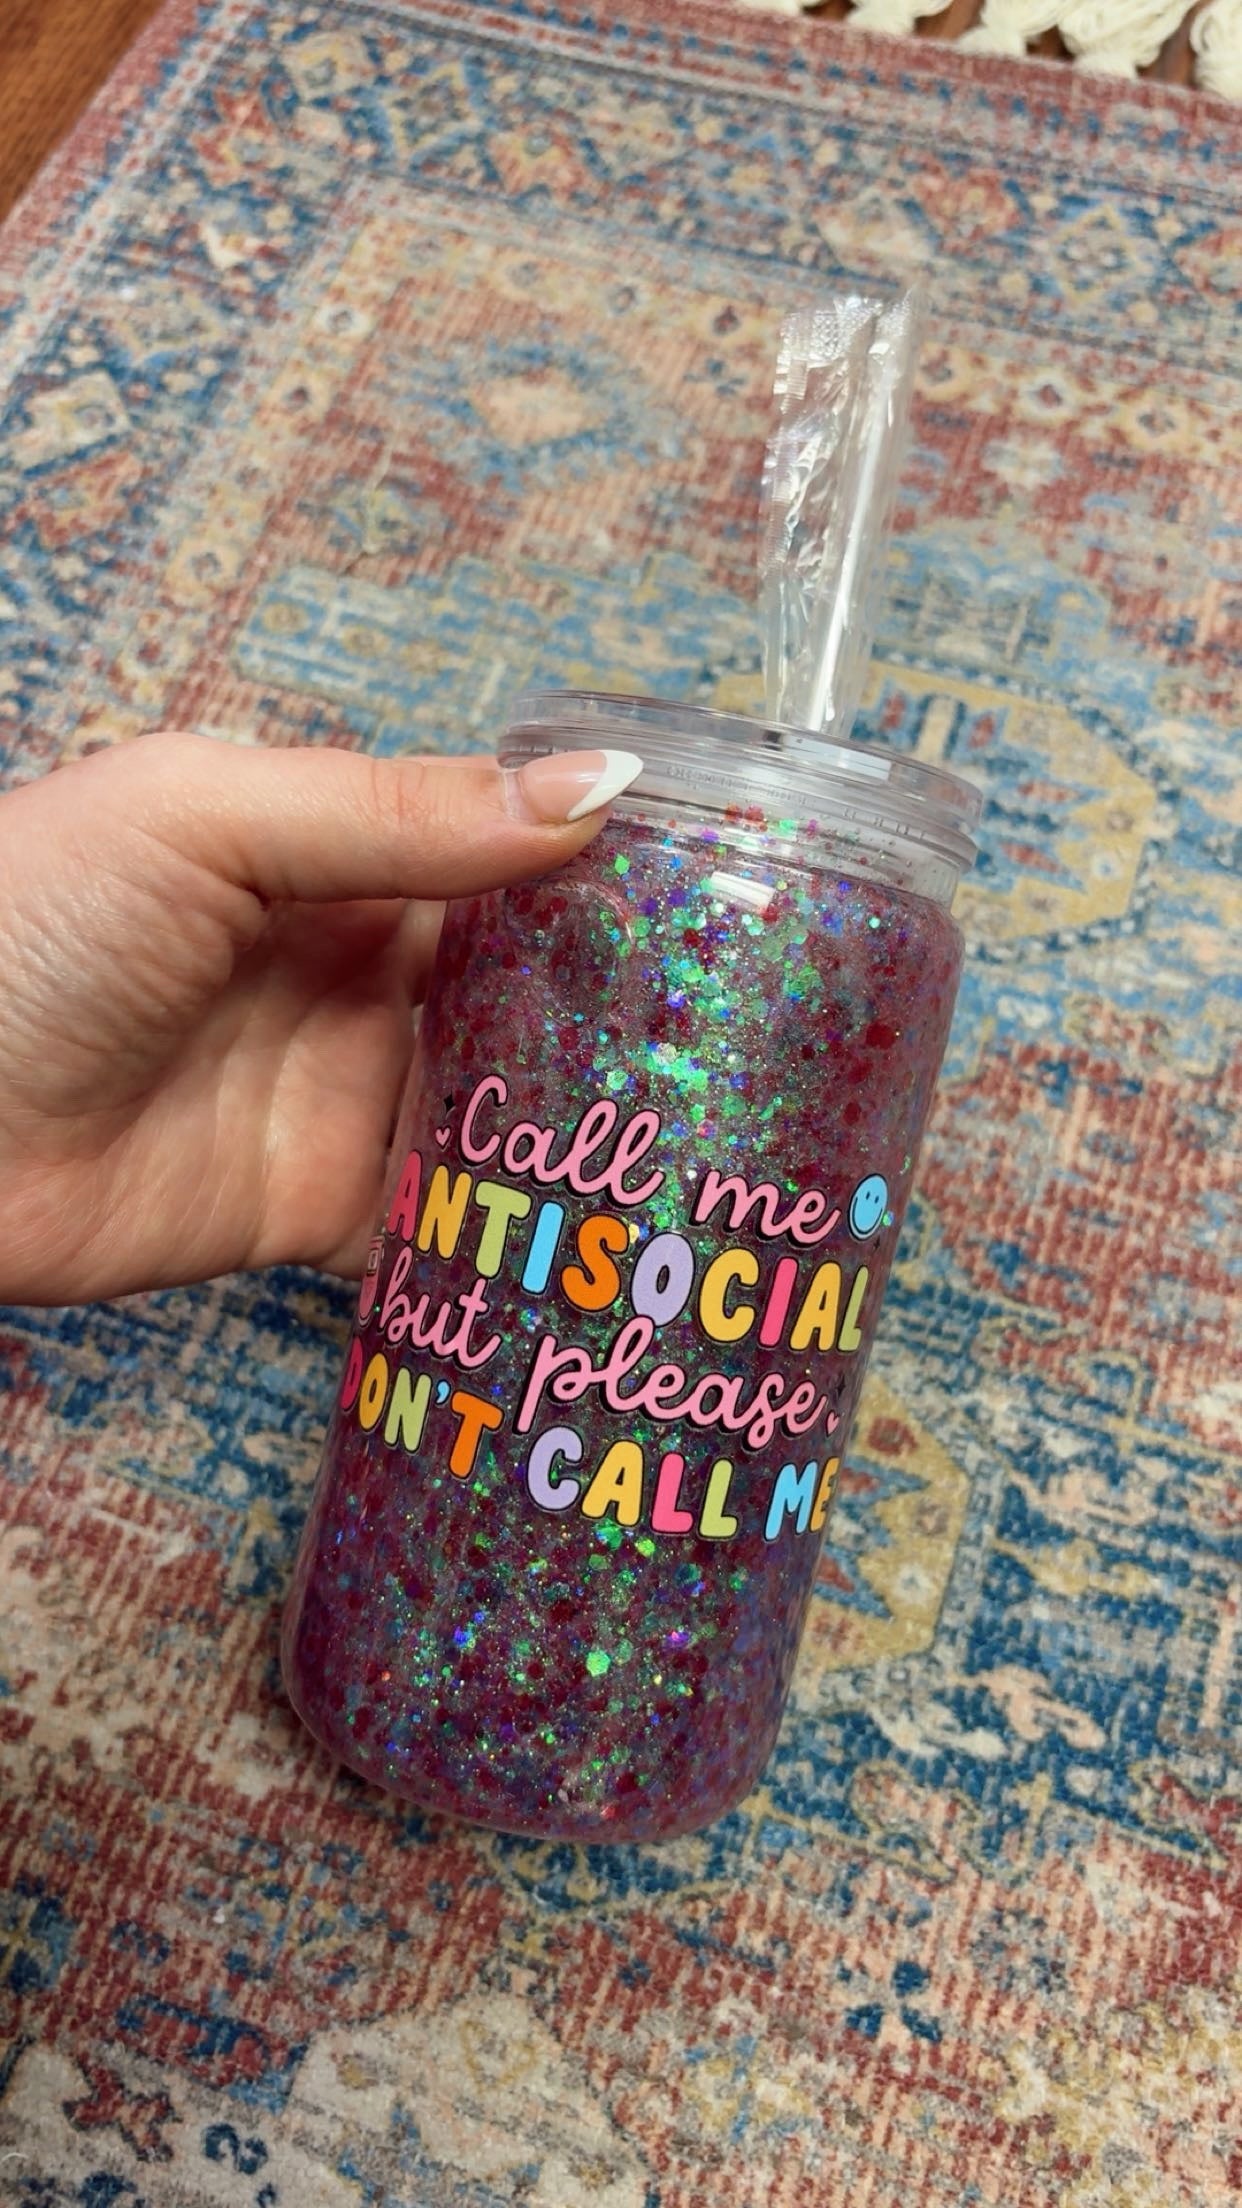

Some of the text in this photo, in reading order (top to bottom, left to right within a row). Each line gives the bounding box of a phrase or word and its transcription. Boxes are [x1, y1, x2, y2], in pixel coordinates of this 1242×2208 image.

[387, 1150, 868, 1352] ANTISOCIAL
[460, 1075, 841, 1245] Call me
[341, 1336, 504, 1478] DON'T
[526, 1426, 738, 1540] CALL
[379, 1247, 828, 1451] but please
